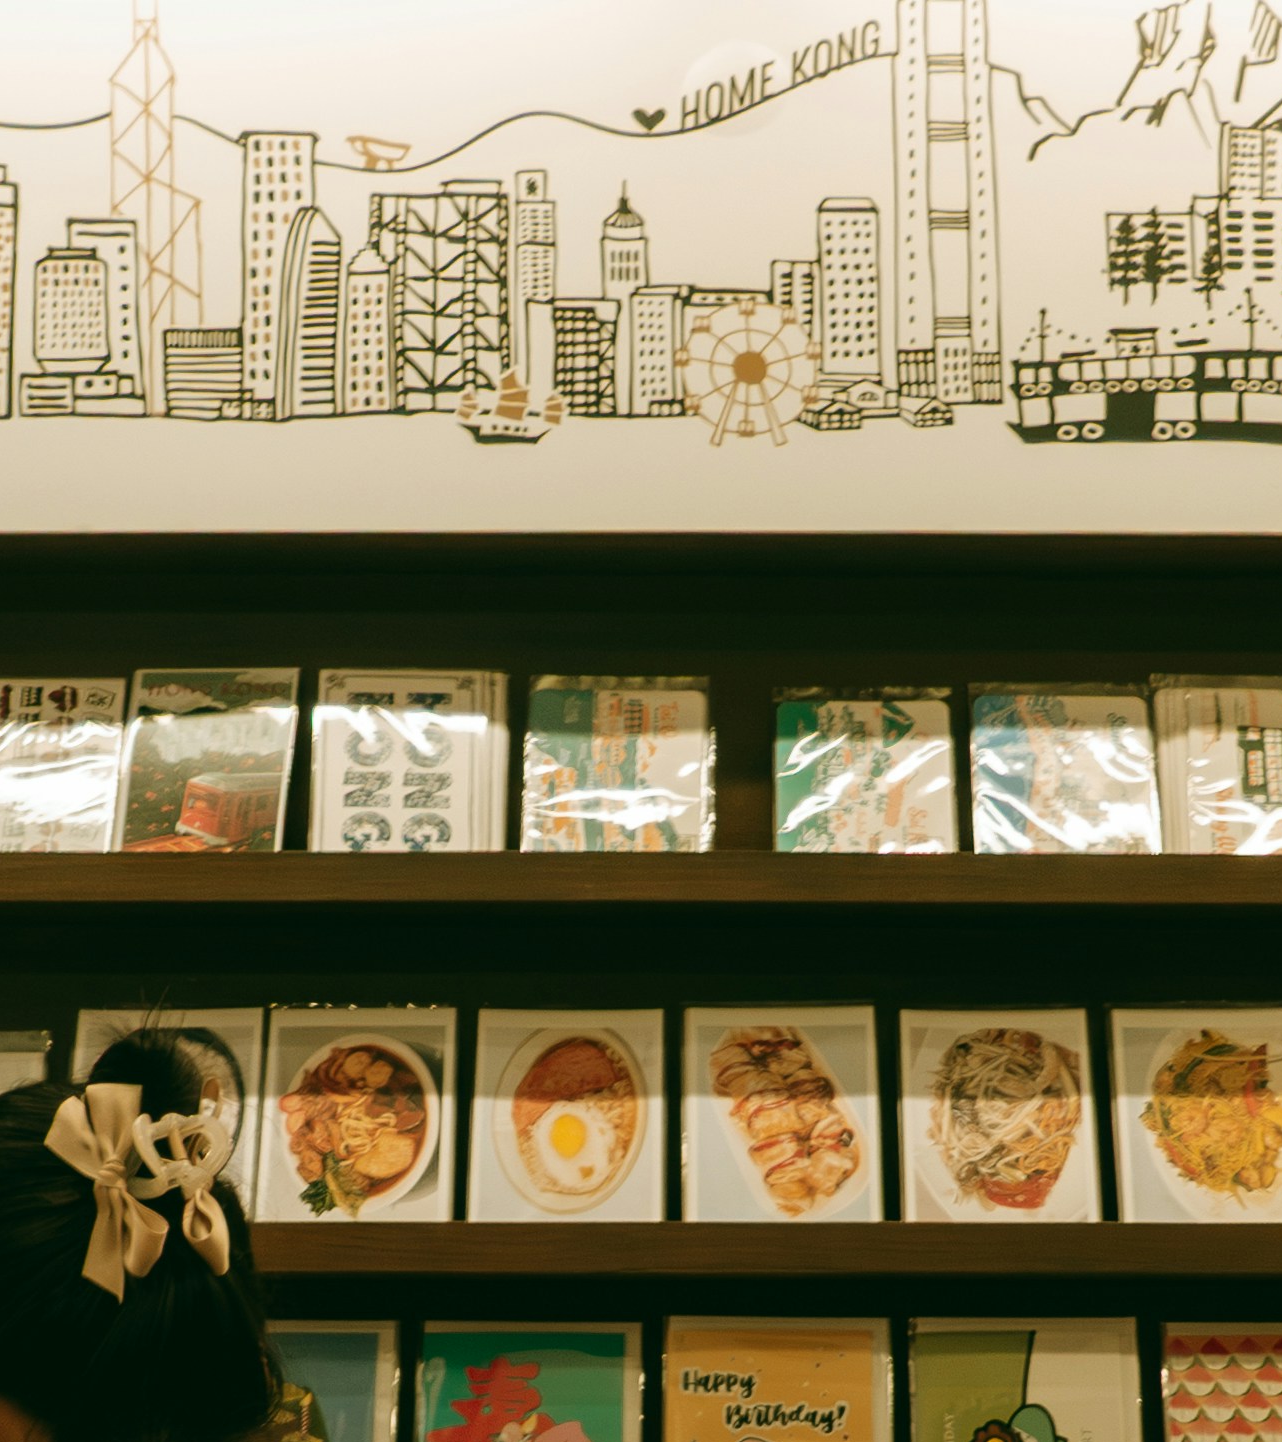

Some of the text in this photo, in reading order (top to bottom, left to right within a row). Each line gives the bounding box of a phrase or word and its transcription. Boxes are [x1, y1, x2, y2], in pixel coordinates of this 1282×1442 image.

[680, 20, 882, 131] HOME KONG
[680, 1369, 758, 1399] Happy
[724, 1402, 849, 1434] Birthday!
